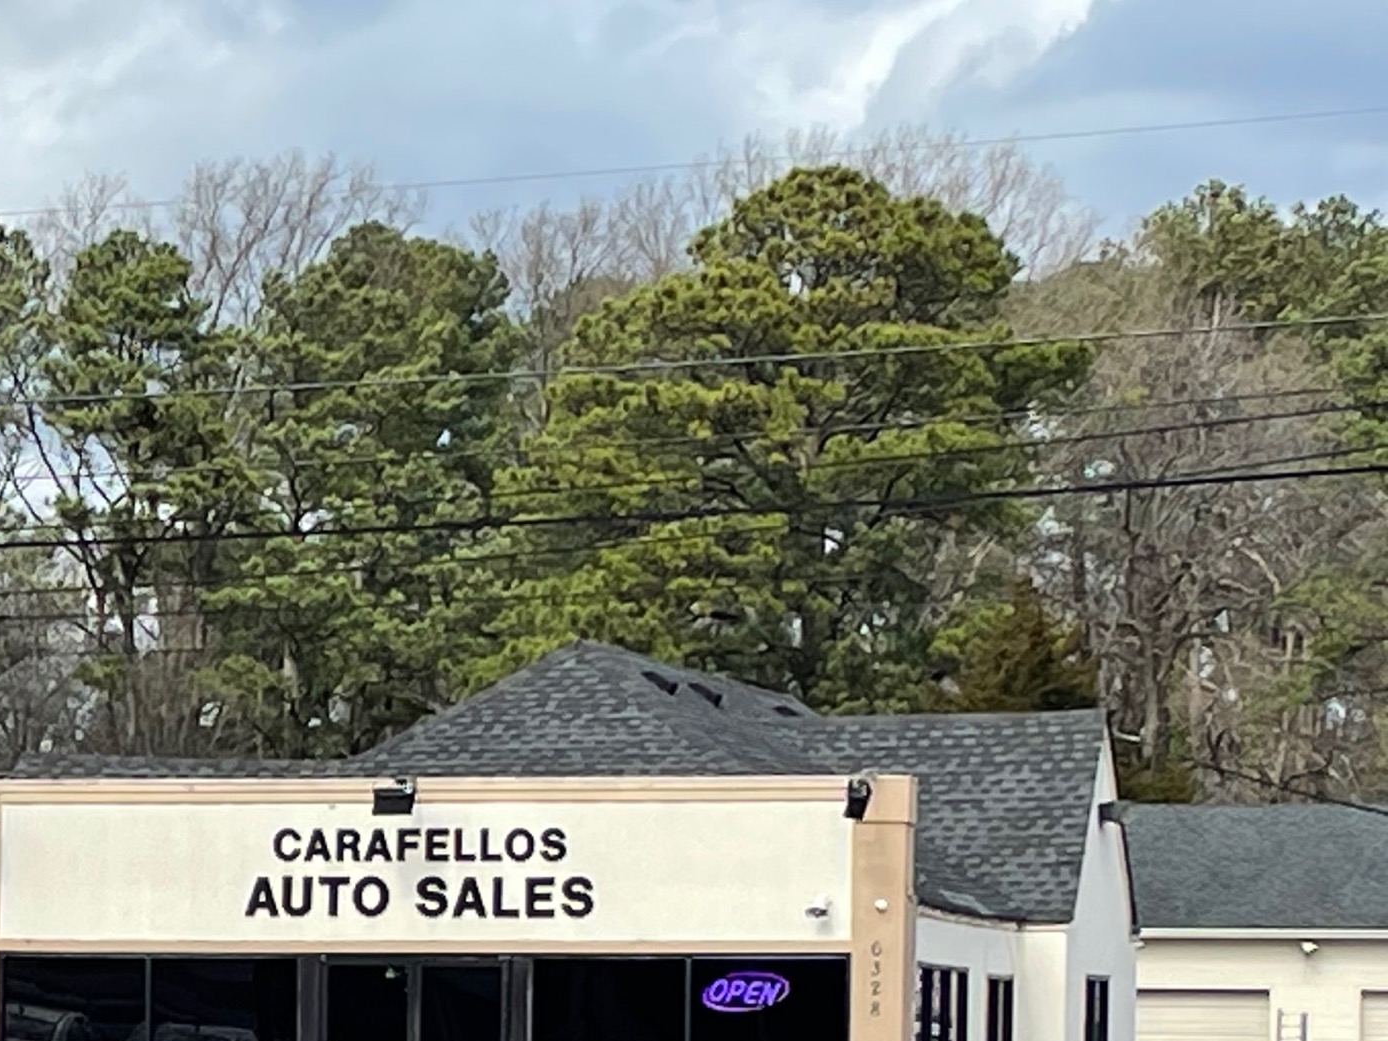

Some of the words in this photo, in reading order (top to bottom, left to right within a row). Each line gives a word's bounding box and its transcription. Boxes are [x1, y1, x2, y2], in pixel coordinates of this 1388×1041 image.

[273, 828, 567, 862] CARAFELLOS
[245, 876, 390, 917] AUTO
[415, 876, 595, 918] SALES
[708, 978, 782, 1006] OPEN
